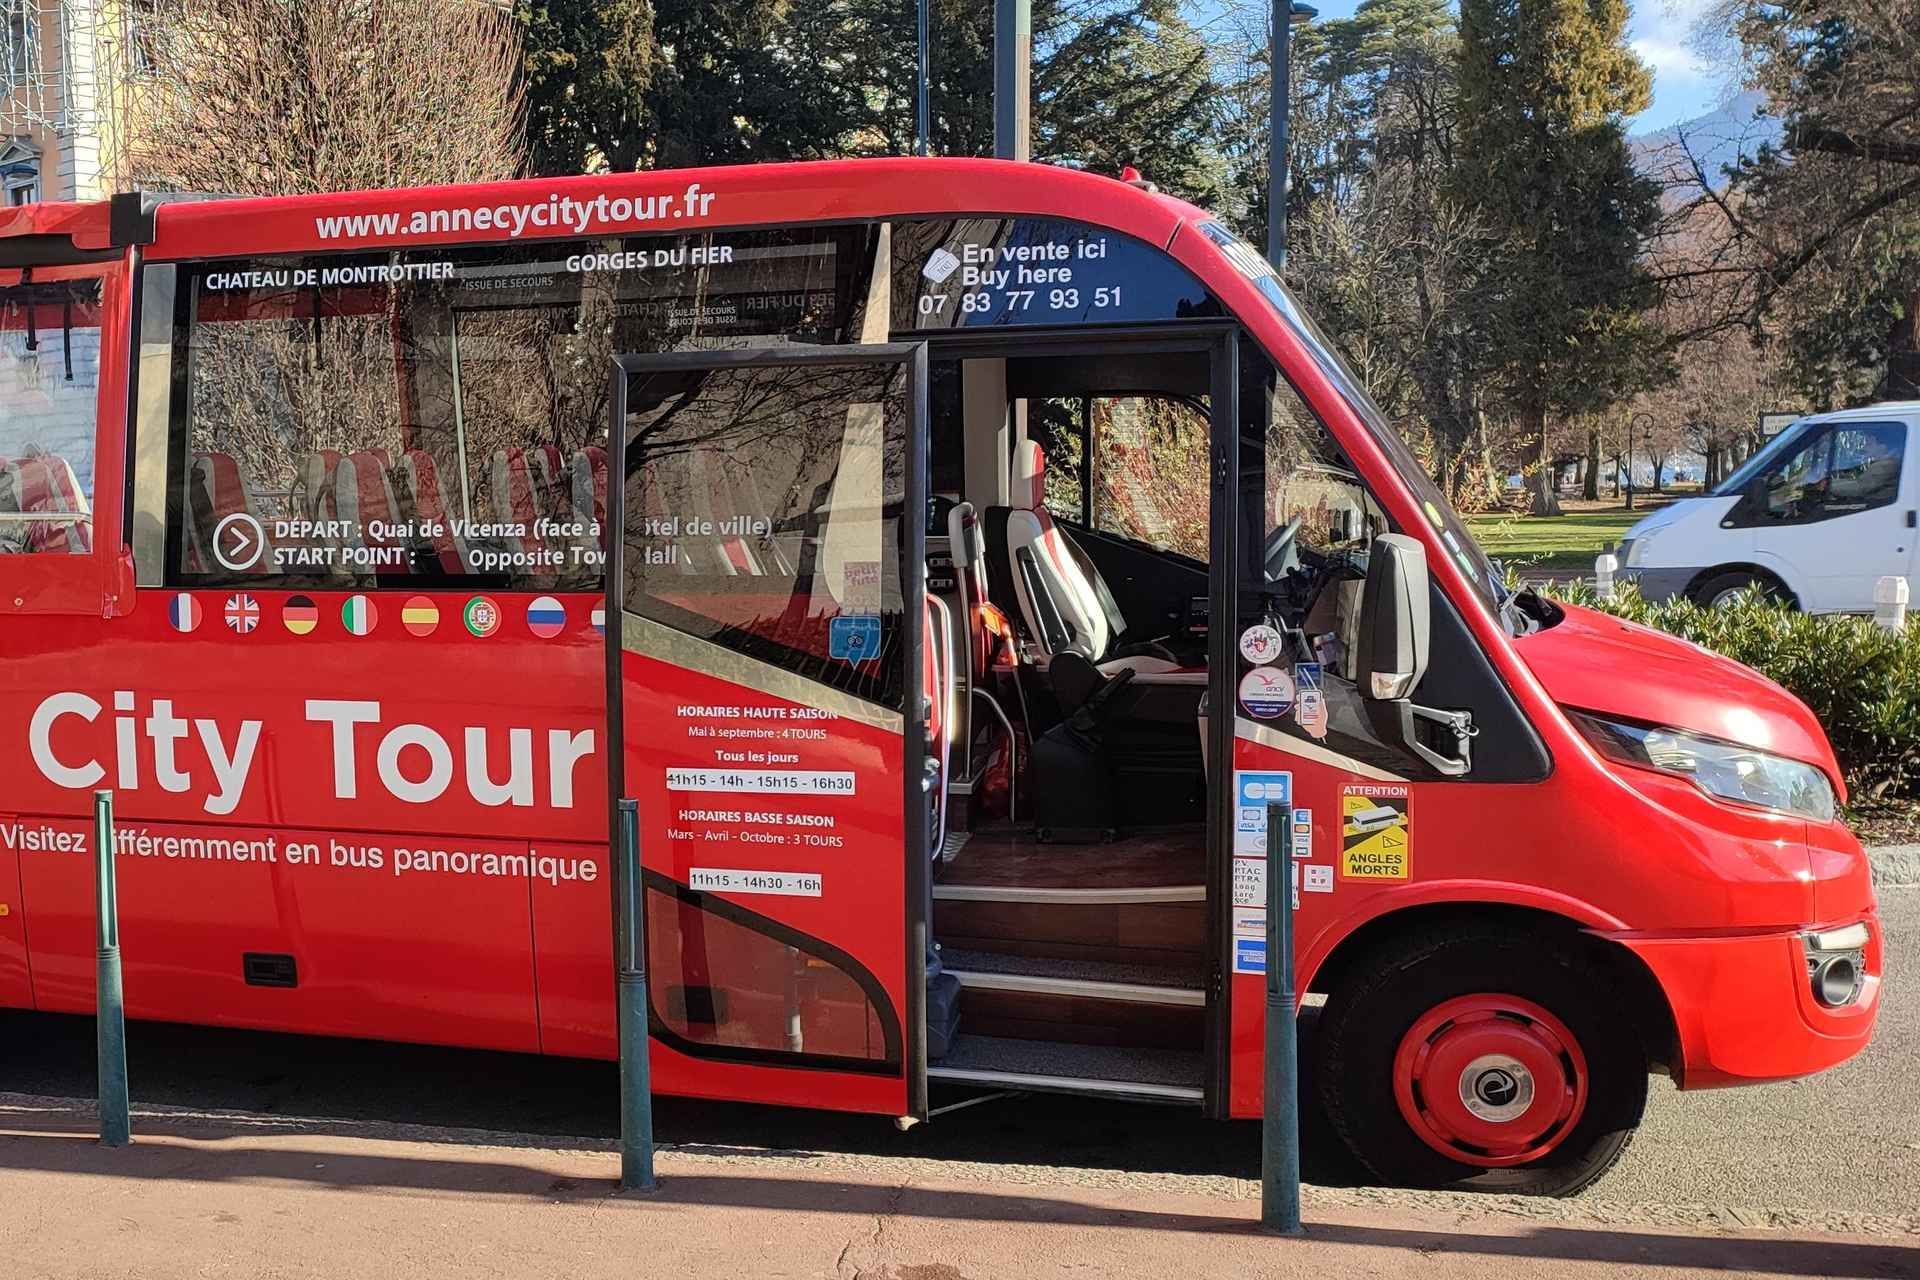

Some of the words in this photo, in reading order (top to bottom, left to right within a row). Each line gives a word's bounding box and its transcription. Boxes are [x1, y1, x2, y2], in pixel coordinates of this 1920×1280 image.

[315, 183, 716, 240] www.annecycitytour.fr
[565, 250, 648, 273] GORGES
[654, 248, 685, 267] DU
[691, 245, 733, 265] FIER
[963, 243, 994, 263] En
[1002, 241, 1070, 262] vente
[1077, 238, 1106, 259] ici
[205, 270, 290, 290] CHATEAU
[293, 268, 318, 287] DE
[322, 261, 455, 285] MONTROTTIER
[465, 279, 493, 291] ISSUE
[494, 279, 508, 289] DE
[510, 276, 554, 288] SECOURS
[962, 266, 1010, 289] Buy
[1017, 264, 1072, 284] here
[918, 294, 947, 314] 07
[962, 292, 991, 313] 83
[1005, 290, 1035, 311] 77
[1050, 288, 1079, 309] 93
[1094, 286, 1121, 307] 51
[274, 516, 352, 539] DÉPART
[367, 519, 414, 542] Quai
[419, 519, 444, 538] de
[450, 519, 526, 538] Vicenza
[533, 519, 583, 541] (face
[589, 517, 601, 537] à
[685, 515, 713, 536] de
[718, 514, 773, 539] ville)
[273, 546, 340, 566] START
[342, 546, 405, 565] POINT
[469, 546, 564, 570] Opposite
[676, 705, 740, 718] HORAIRES
[743, 707, 787, 719] HAUTE
[789, 708, 839, 720] SAISON
[709, 727, 715, 737] à
[718, 727, 774, 740] septembre
[782, 728, 789, 738] 4
[791, 728, 826, 740] TOURS
[28, 690, 263, 815] City
[304, 699, 596, 808] Tour
[715, 750, 745, 762] Tous
[748, 750, 764, 762] les
[766, 751, 799, 765] jours
[720, 775, 743, 787] 14h
[757, 776, 798, 788] 15h15
[812, 777, 853, 790] 16h30
[1343, 785, 1408, 796] ATTENTION
[678, 809, 741, 823] HORAIRES
[744, 812, 783, 825] BASSE
[786, 814, 834, 828] SAISON
[667, 829, 694, 840] Mars
[704, 829, 729, 841] Avril
[740, 831, 785, 844] Octobre
[794, 834, 800, 844] 3
[803, 834, 843, 848] TOURS
[0, 823, 87, 854] Visitez
[112, 828, 277, 863] ifféremment
[285, 843, 320, 864] en
[330, 843, 384, 869] bus
[394, 845, 598, 886] panoramique
[1348, 853, 1402, 865] ANGLES
[1351, 864, 1400, 876] MORTS
[691, 873, 729, 886] 11h15
[743, 876, 783, 889] 14h30
[797, 879, 821, 891] 16h
